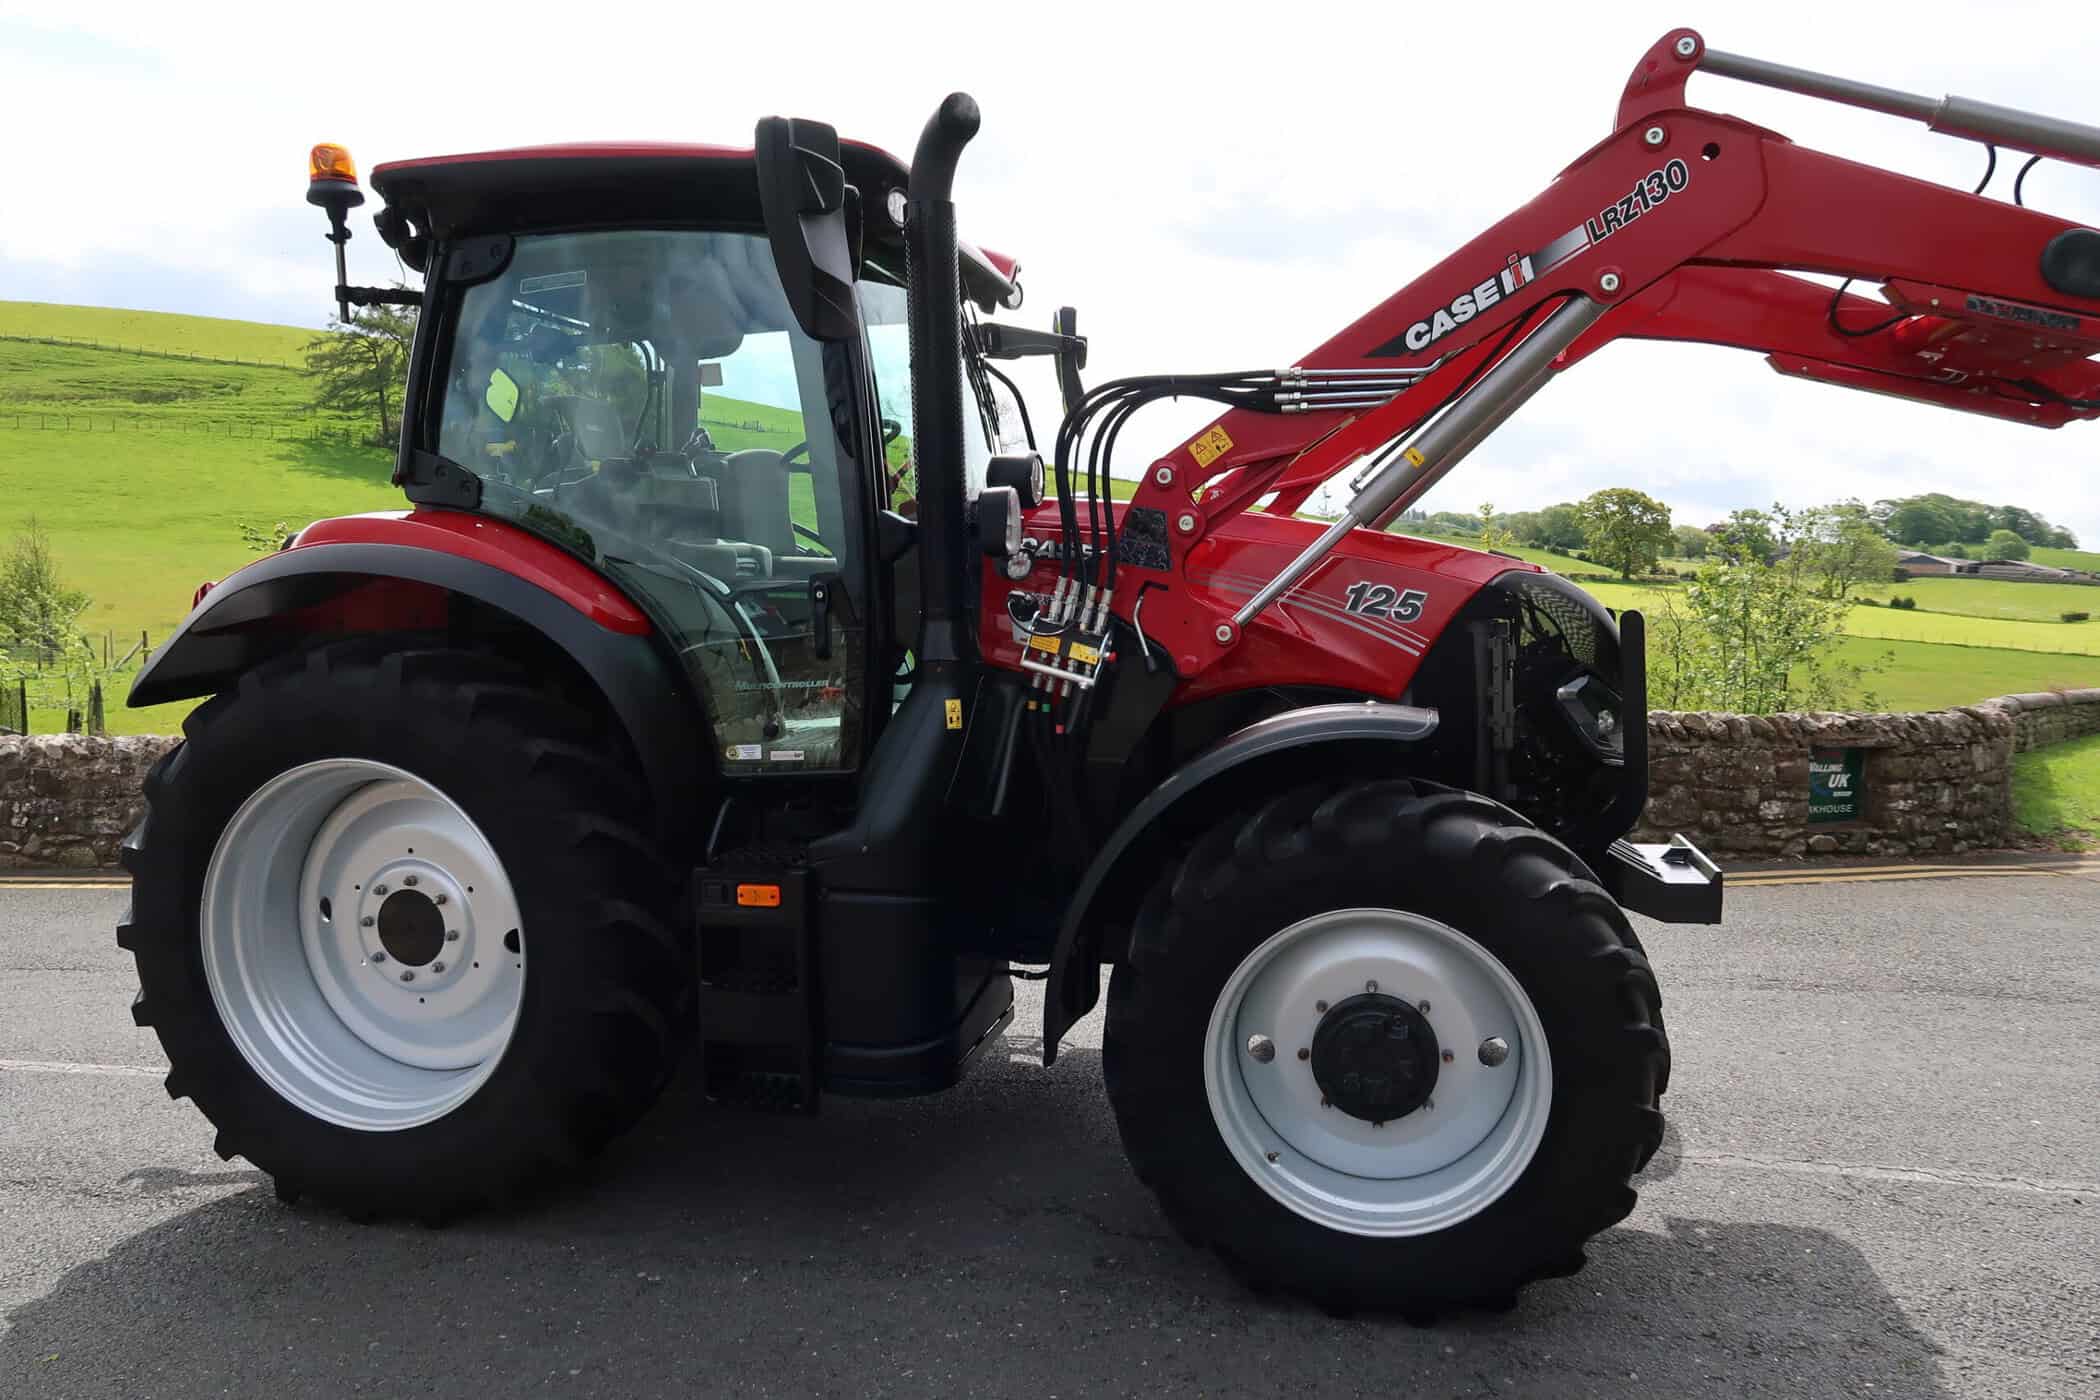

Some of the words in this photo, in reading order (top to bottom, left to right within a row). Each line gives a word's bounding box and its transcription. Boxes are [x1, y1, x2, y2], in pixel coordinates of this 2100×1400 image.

[1586, 158, 1689, 245] LRZ130
[1405, 277, 1501, 350] CASE
[1344, 580, 1429, 624] 125
[1828, 774, 1852, 788] UK
